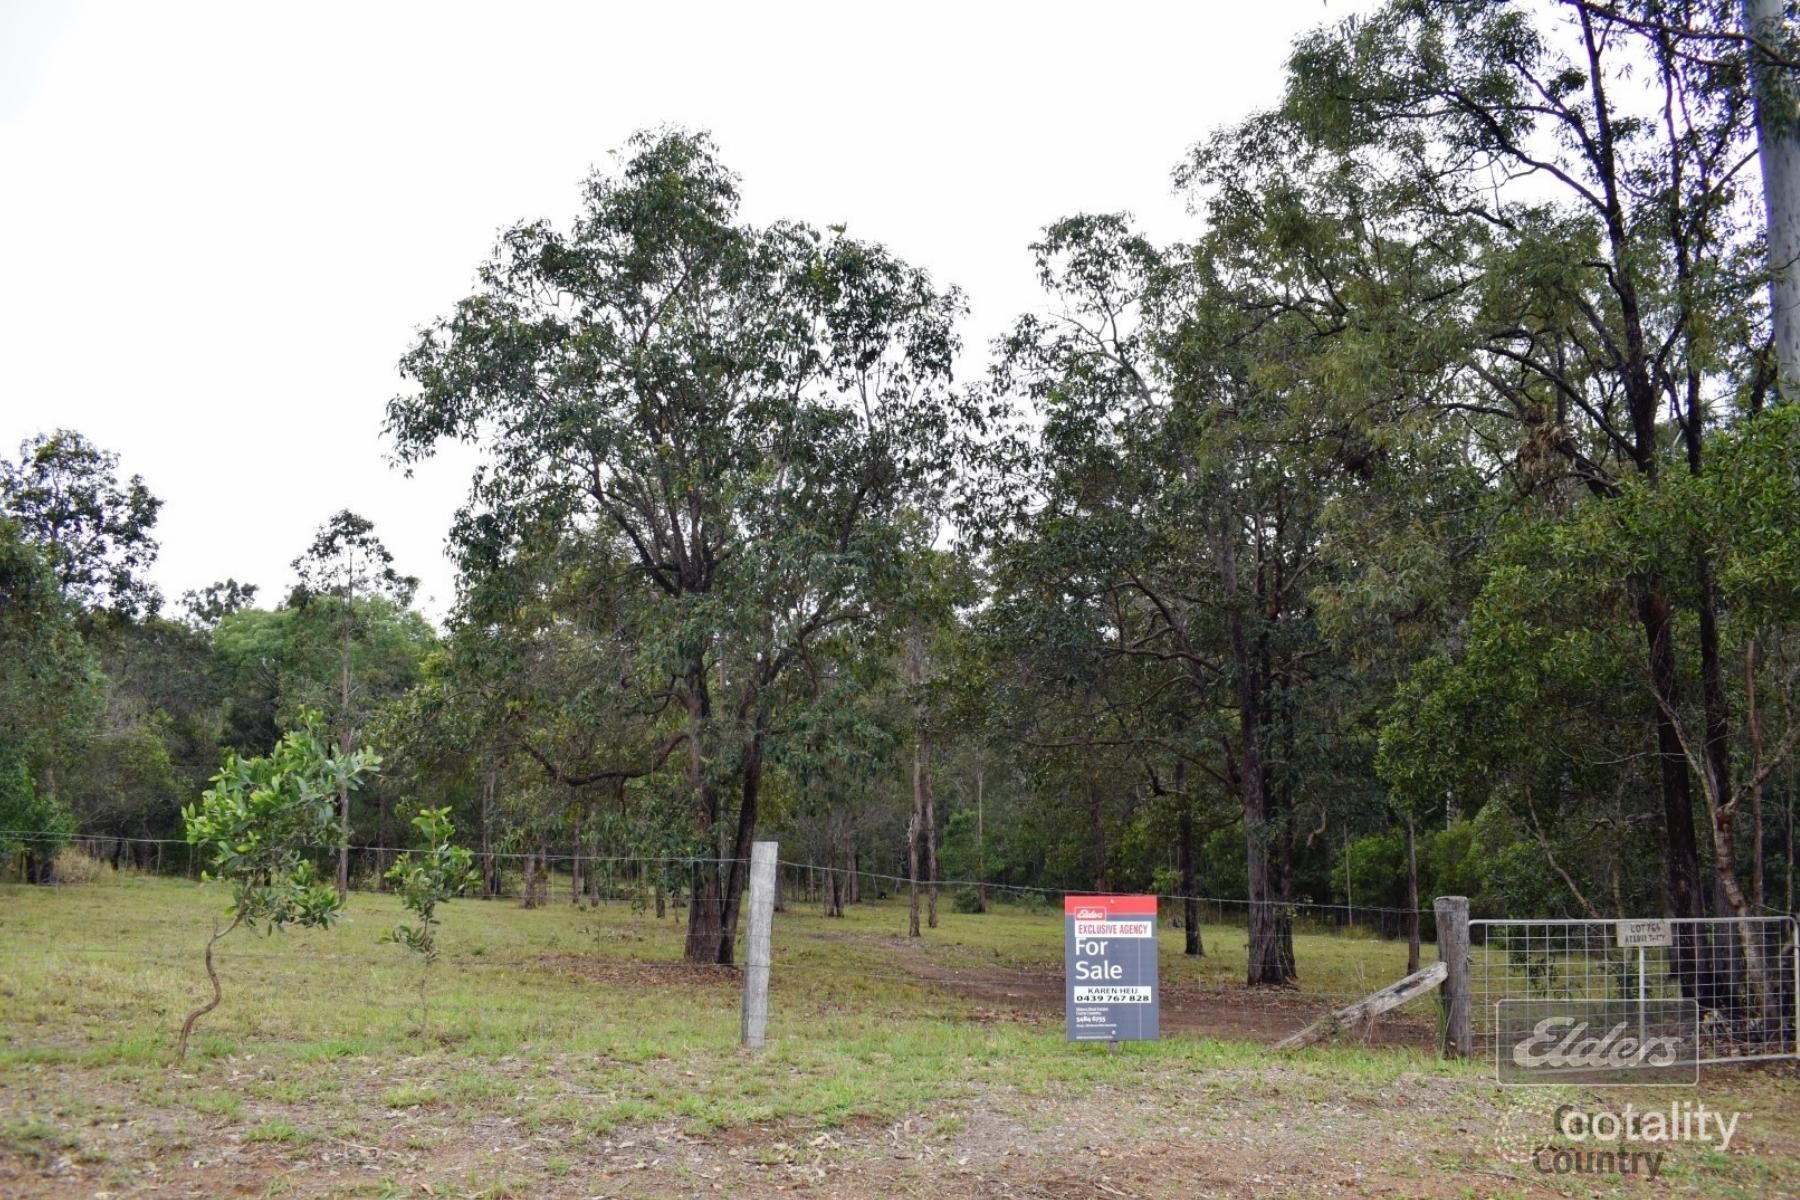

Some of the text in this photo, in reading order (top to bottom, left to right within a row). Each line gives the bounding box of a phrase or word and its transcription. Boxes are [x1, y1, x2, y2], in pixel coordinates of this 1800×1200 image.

[1078, 924, 1148, 934] EXCLUSIVE AGENCY
[1630, 924, 1646, 933] LOT
[1075, 937, 1109, 956] For
[1075, 960, 1123, 980] Sale
